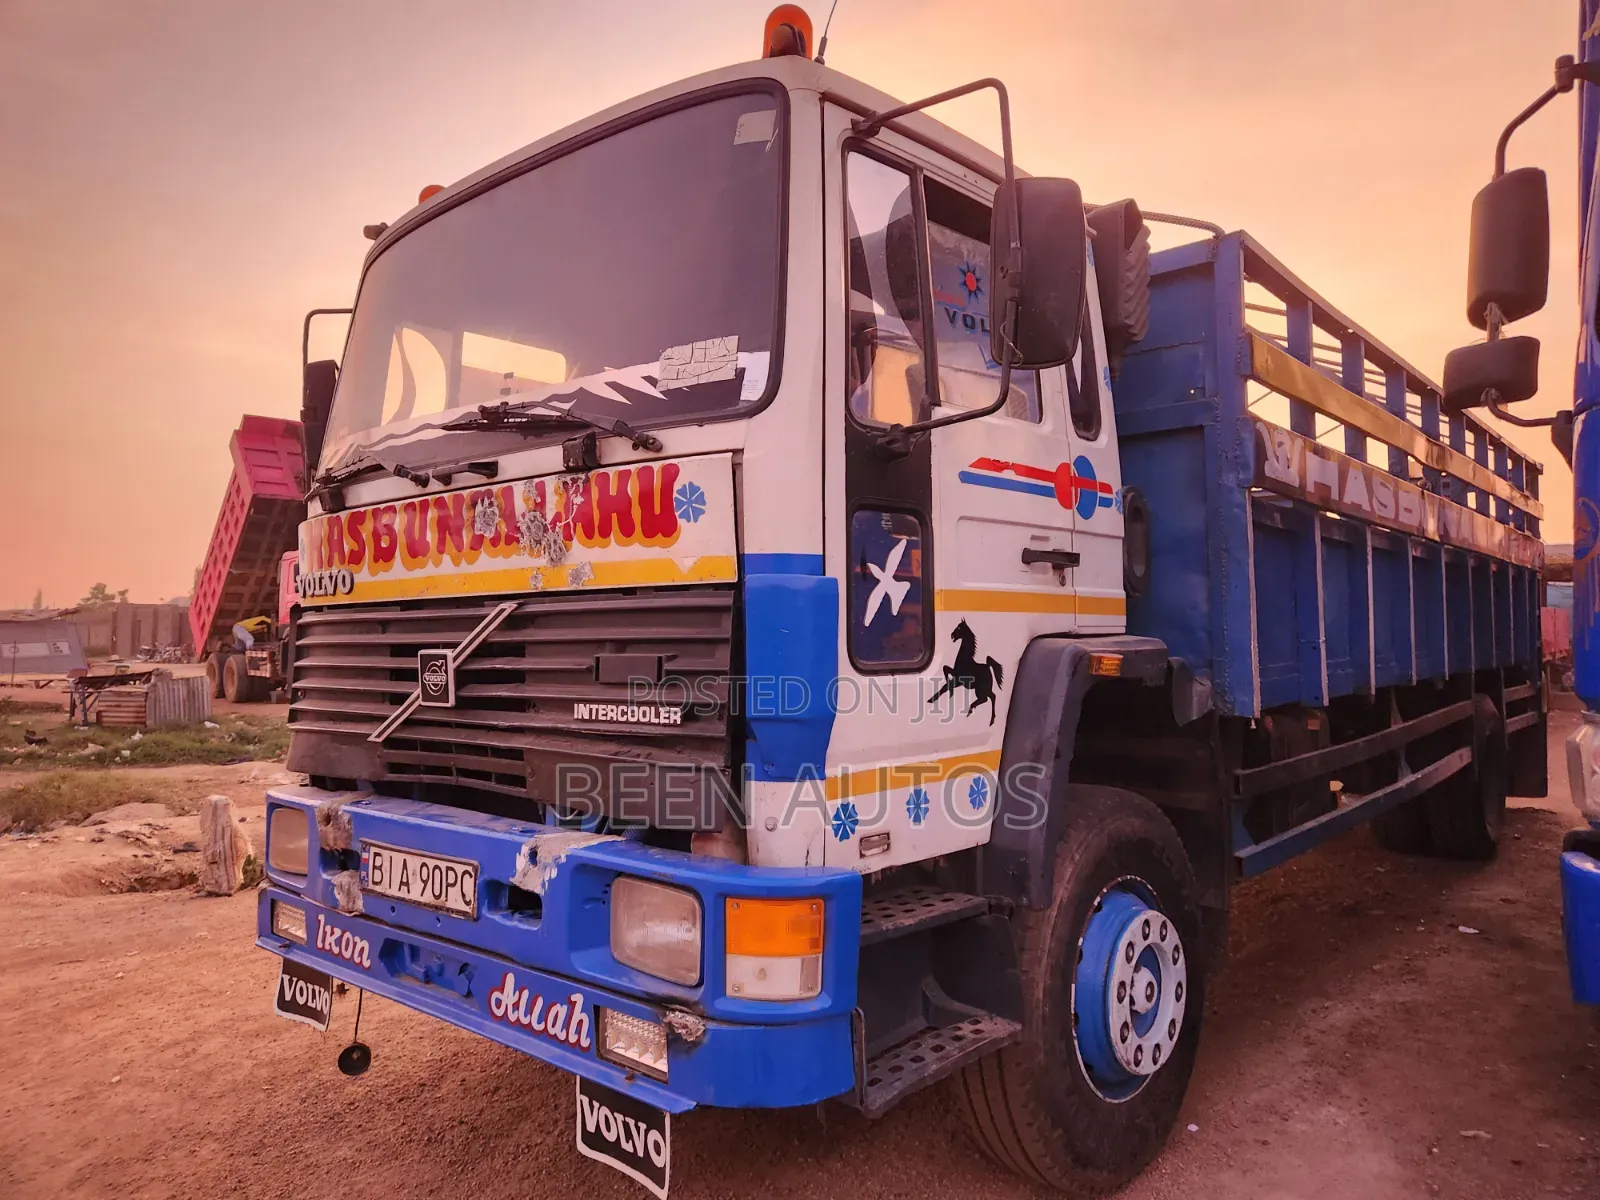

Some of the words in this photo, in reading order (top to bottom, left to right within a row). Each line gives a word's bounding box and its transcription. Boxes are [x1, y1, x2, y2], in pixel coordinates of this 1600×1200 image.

[944, 306, 991, 333] VOL
[296, 569, 354, 598] VOLVO
[424, 674, 446, 682] VOLVO
[573, 703, 682, 724] INTERCOOLER
[371, 851, 410, 894] BIA
[419, 861, 473, 906] 90PC
[282, 973, 330, 1015] VOLVO
[580, 1093, 666, 1168] VOLVO
